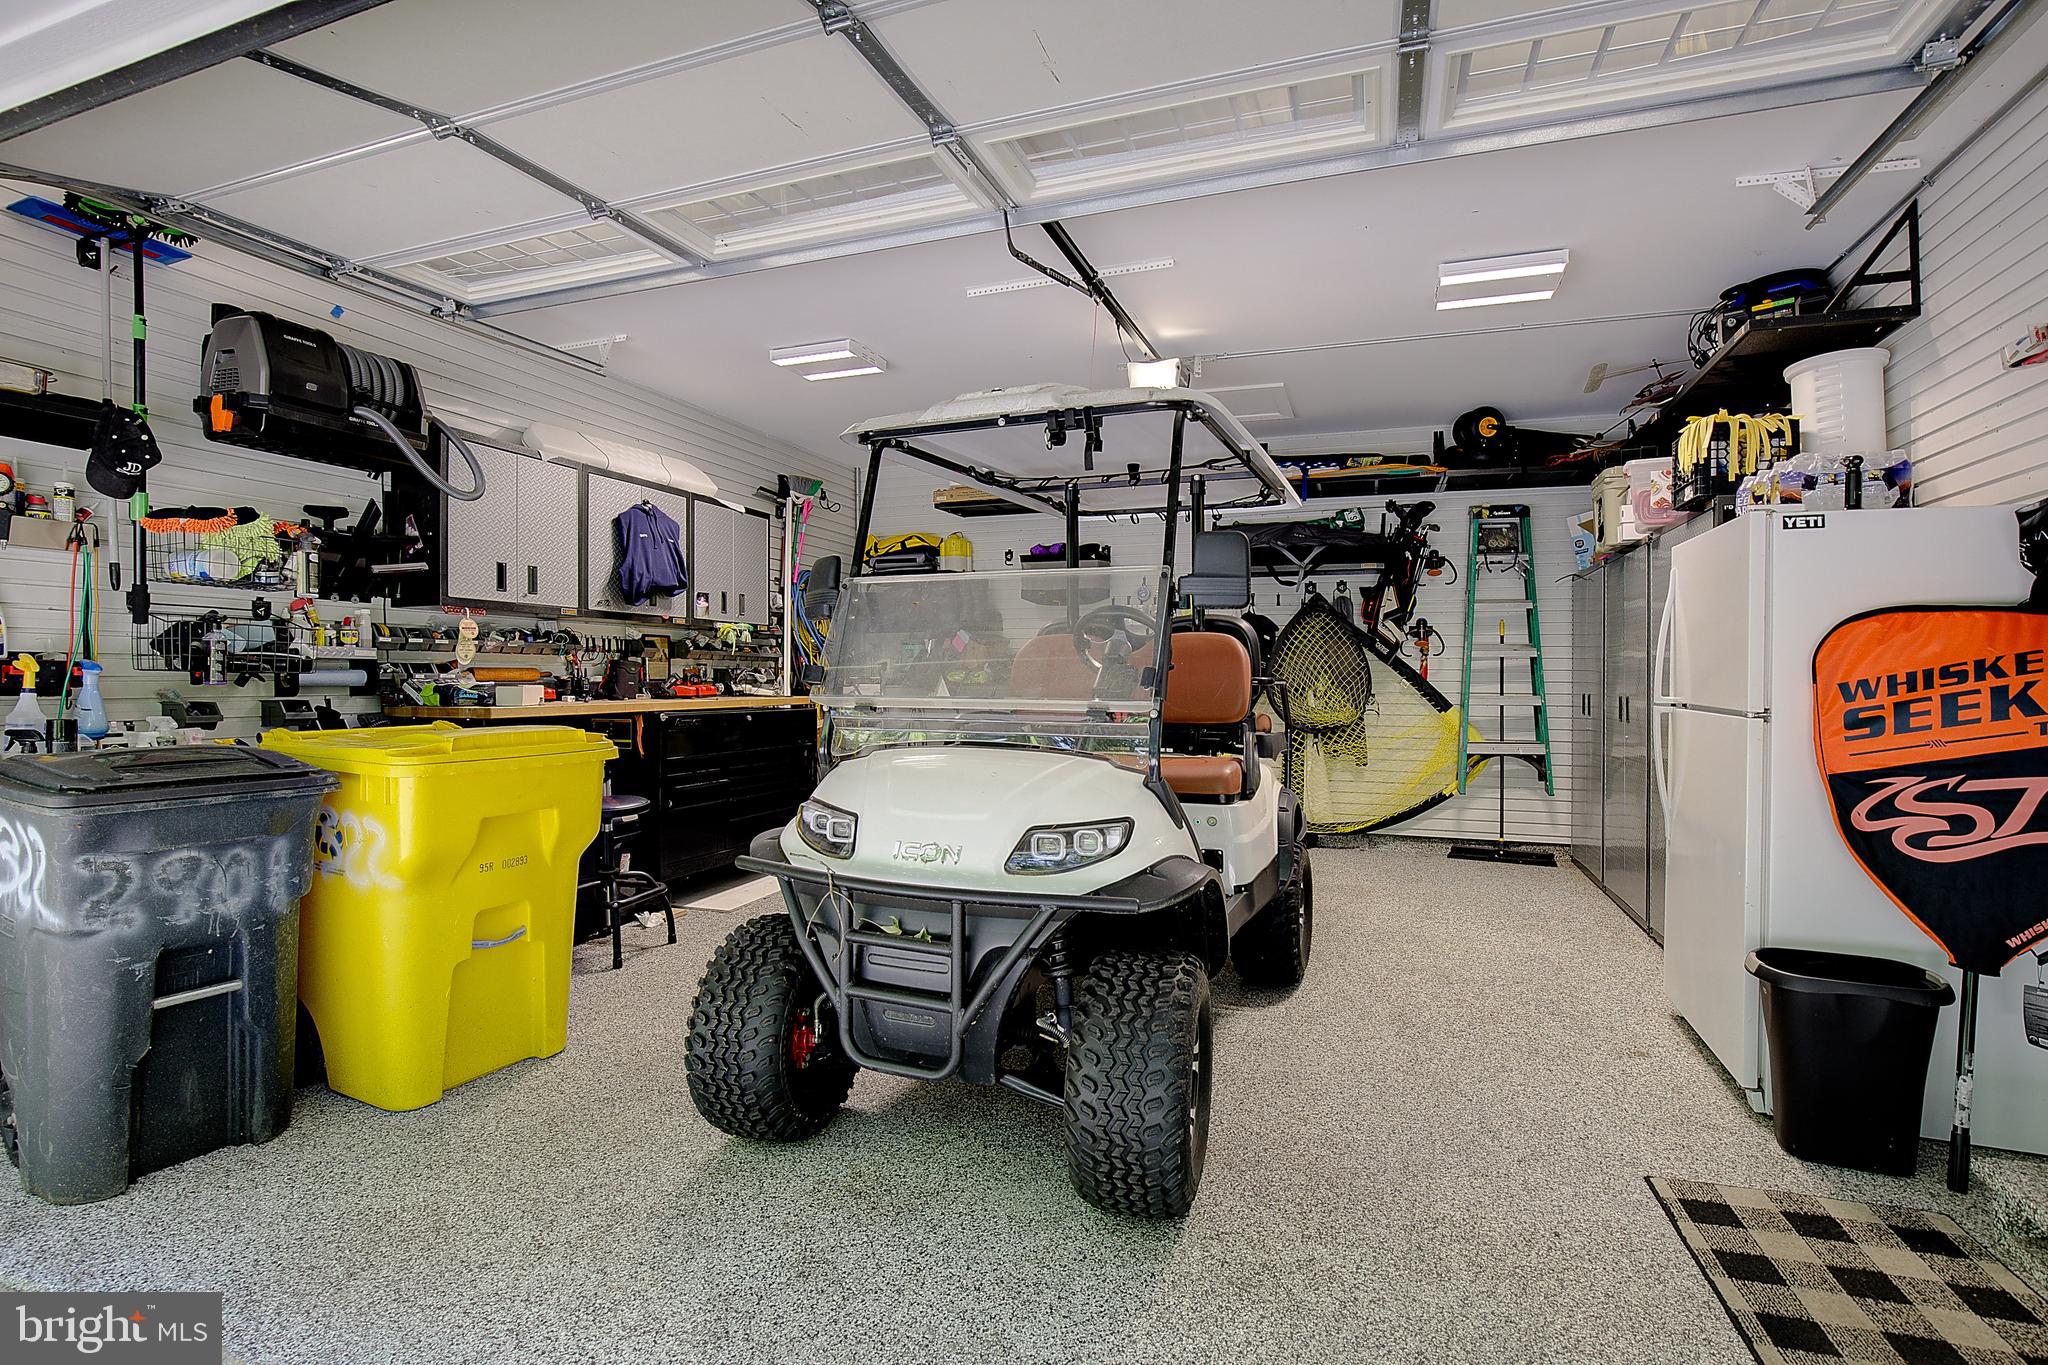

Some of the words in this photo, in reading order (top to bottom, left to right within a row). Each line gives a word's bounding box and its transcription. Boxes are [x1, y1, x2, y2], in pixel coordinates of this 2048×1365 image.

[1784, 517, 1823, 528] YETI
[1843, 679, 2048, 743] SEEK
[893, 840, 962, 865] ICON
